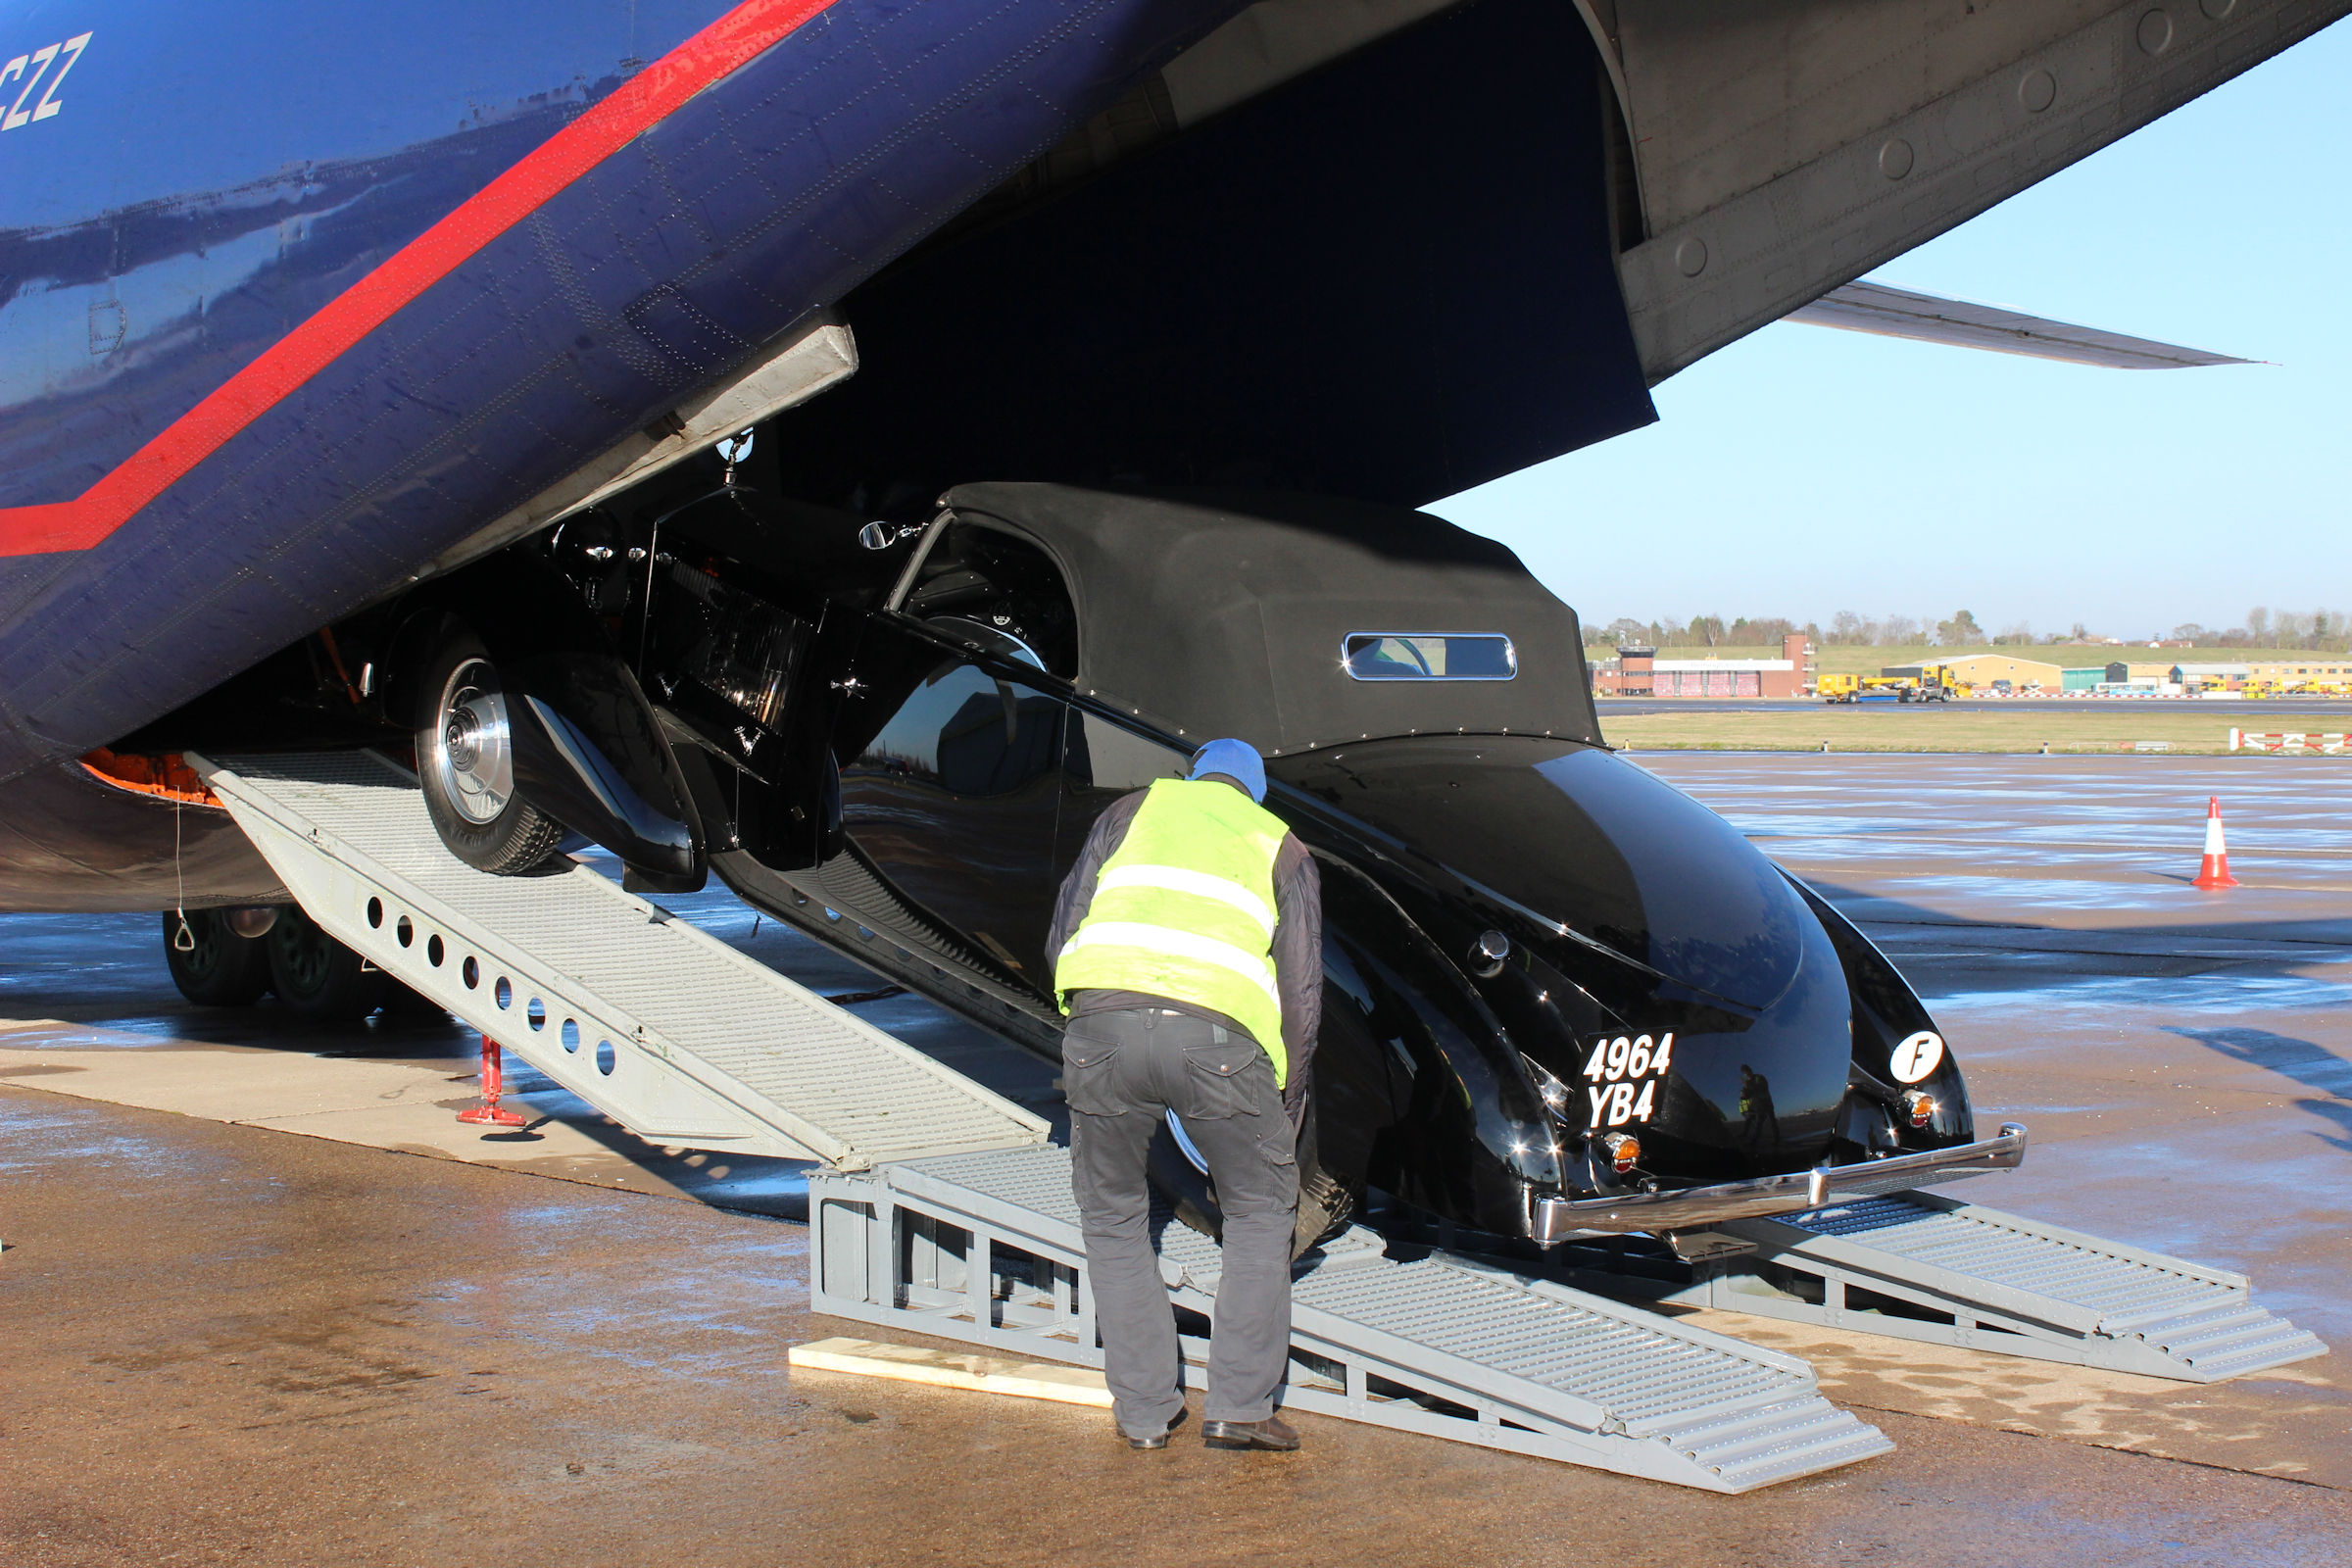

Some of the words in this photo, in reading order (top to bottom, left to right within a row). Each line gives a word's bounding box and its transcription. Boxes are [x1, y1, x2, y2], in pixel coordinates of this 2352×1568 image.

[1583, 1032, 1674, 1083] 4964
[1909, 1039, 1930, 1075] F
[1588, 1079, 1656, 1128] YB4
